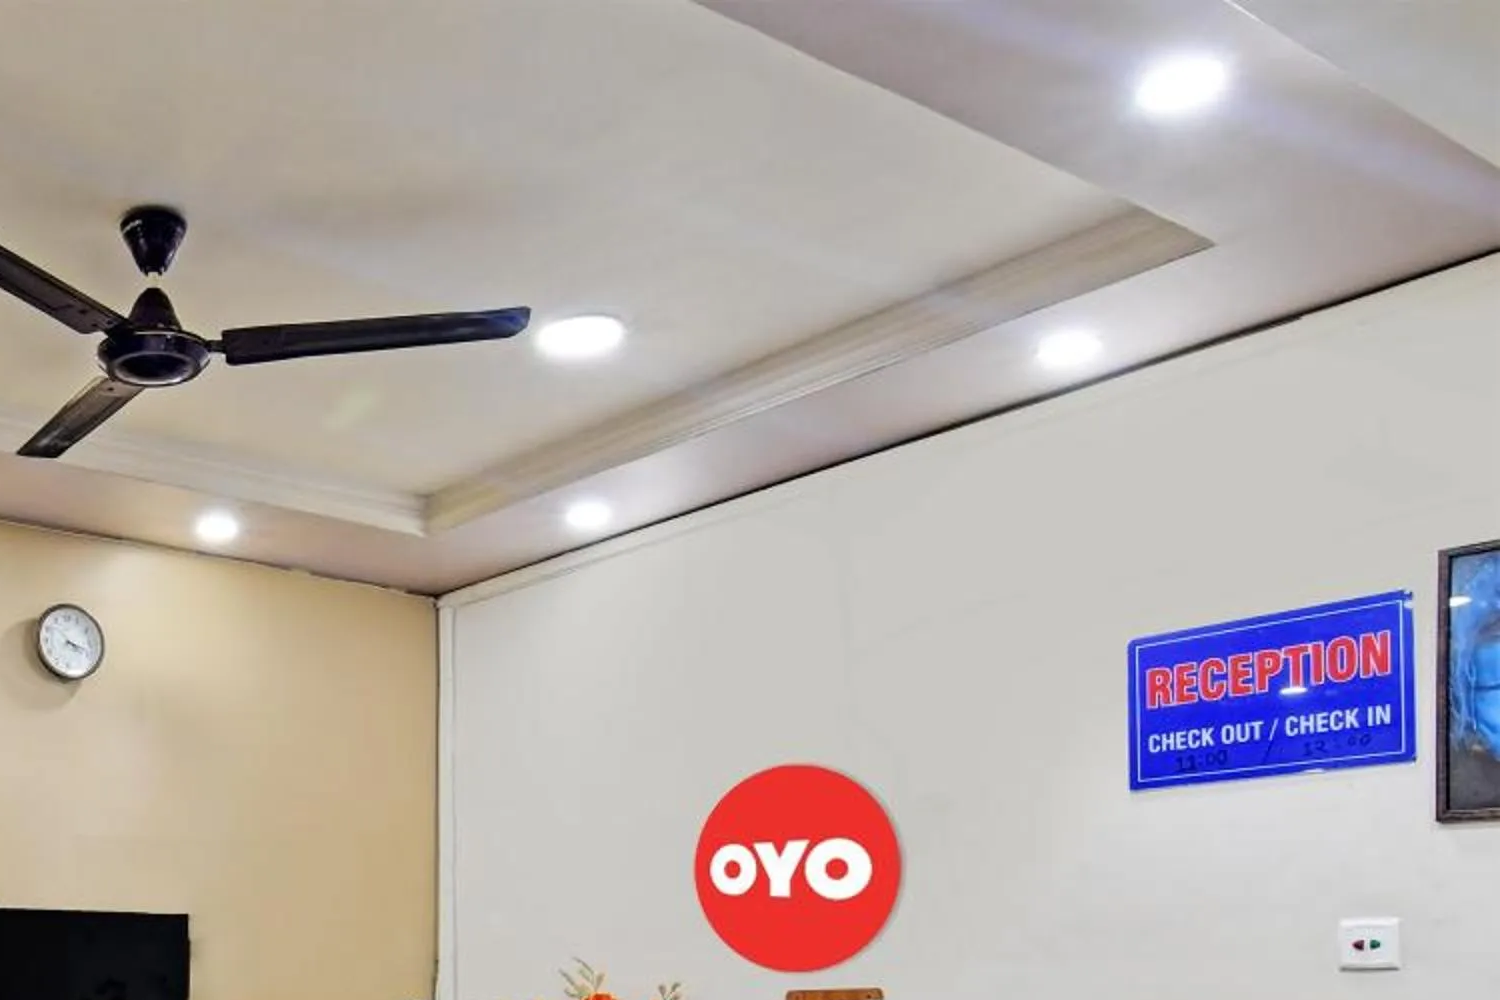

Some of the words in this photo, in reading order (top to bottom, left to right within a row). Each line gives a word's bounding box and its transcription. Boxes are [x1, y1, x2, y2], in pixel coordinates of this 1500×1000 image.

[1145, 631, 1391, 709] RECEPTION
[1148, 726, 1214, 752] CHECK
[1221, 721, 1264, 745] OUT
[1285, 708, 1360, 737] CHECK
[1367, 704, 1391, 726] IN
[710, 838, 872, 900] OYO
